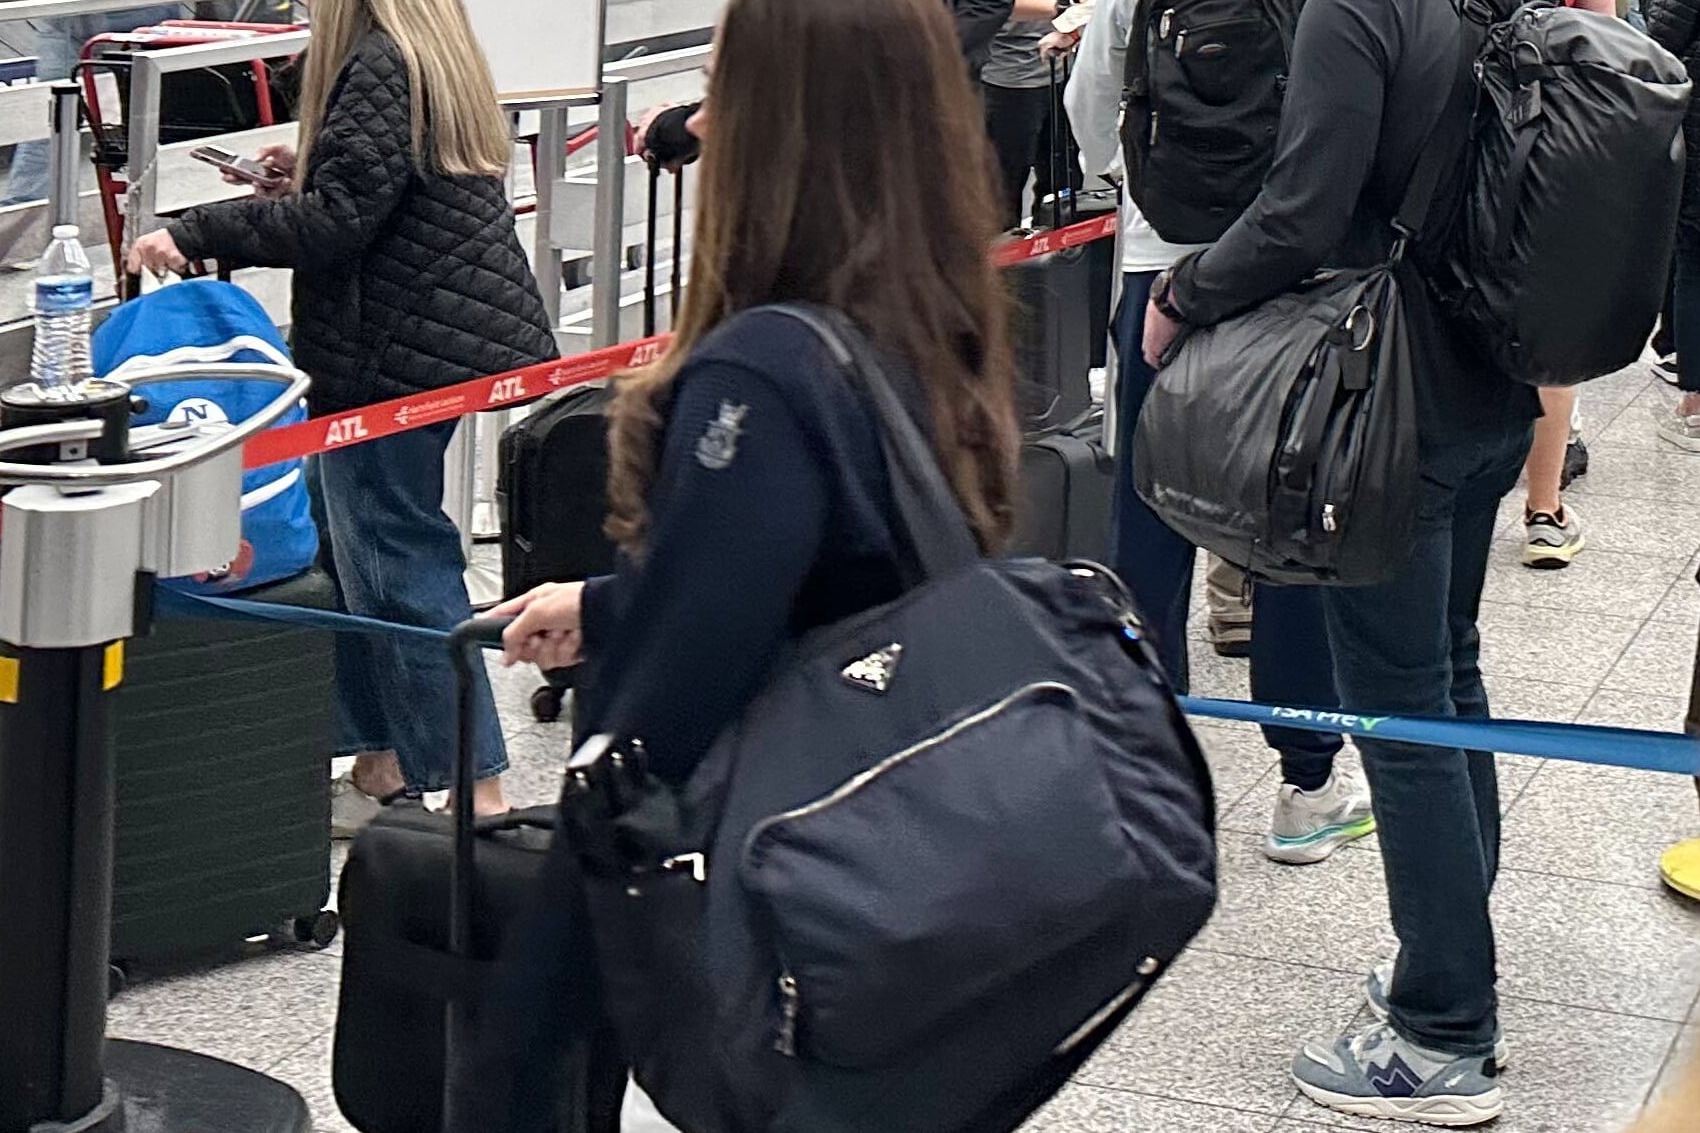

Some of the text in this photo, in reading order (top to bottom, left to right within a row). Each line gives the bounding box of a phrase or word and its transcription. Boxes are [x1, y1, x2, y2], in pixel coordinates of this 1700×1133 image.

[629, 343, 662, 367] ATL
[488, 376, 527, 404] ATL
[180, 403, 208, 421] N
[324, 415, 369, 447] ATL
